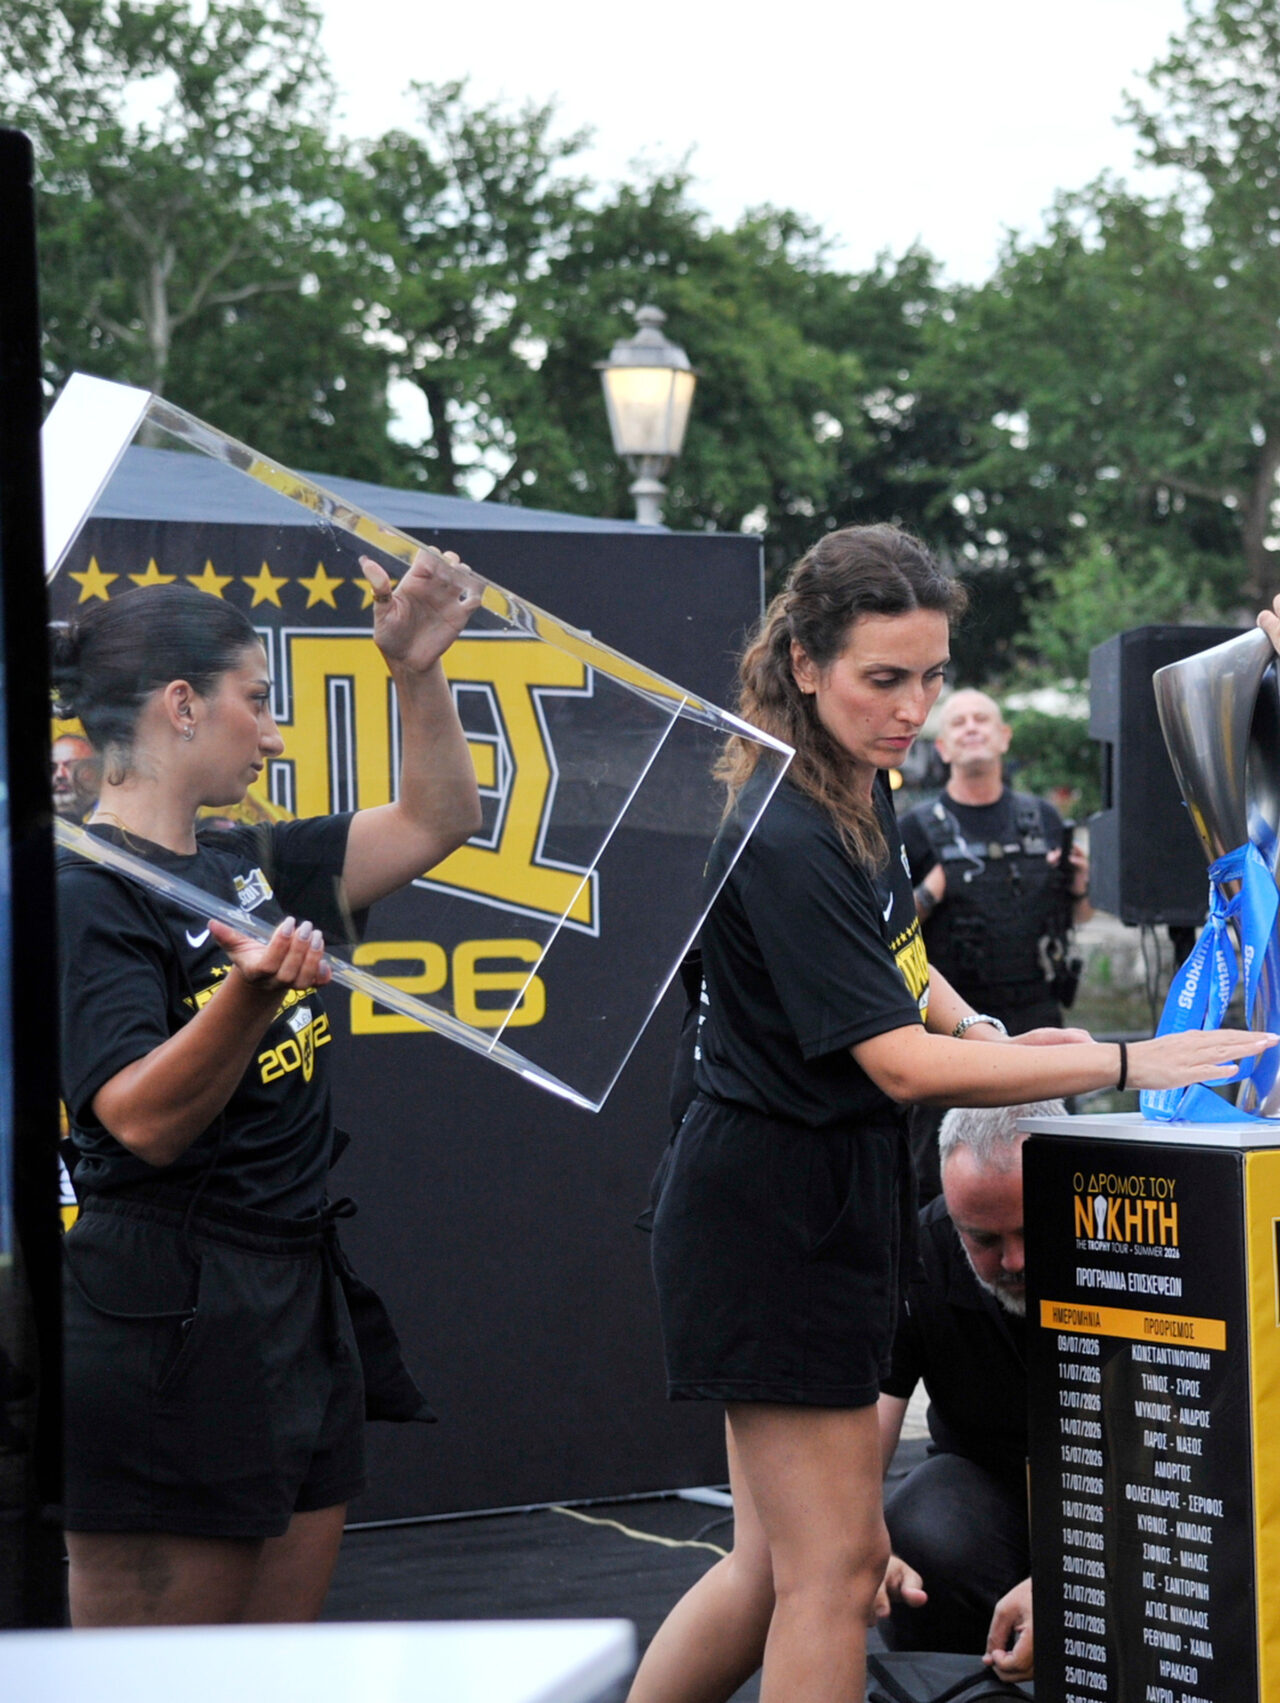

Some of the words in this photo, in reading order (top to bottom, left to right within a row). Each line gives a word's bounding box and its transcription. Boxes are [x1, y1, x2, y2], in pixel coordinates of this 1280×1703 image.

[1073, 1172, 1084, 1192] Ο
[1087, 1173, 1148, 1196] ΔΡΟΜΟΣ
[1149, 1177, 1176, 1197] ΤΟΥ
[1076, 1238, 1087, 1250] THE
[1087, 1240, 1110, 1251] TROPHY
[1111, 1242, 1129, 1254] TOUR
[1134, 1245, 1163, 1257] SUMMER
[1164, 1248, 1181, 1258] 2026
[1076, 1267, 1127, 1291] ΠΡΟΓΡΑΜΜΑ
[1128, 1272, 1182, 1297] ΕΠΙΣΚΕΨΕΩΝ
[1053, 1307, 1101, 1327] ΗΜΕΡΟΜΗΝΙΑ
[1143, 1317, 1195, 1339] ΠΡΟΟΡΙΣΜΟΣ
[1057, 1334, 1099, 1356] 09/07/2026
[1131, 1344, 1210, 1371] ΚΩΝΣΤΑΝΤΙΝΟΥΠΟΛΗ
[1058, 1363, 1101, 1384] 11/07/2026
[1141, 1373, 1169, 1392] ΤΗΝΟΣ
[1176, 1378, 1200, 1397] ΣΥΡΟΣ
[1059, 1390, 1101, 1412] 12/07/2026
[1135, 1400, 1171, 1420] ΜΥΚΟΝΟΣ
[1180, 1407, 1210, 1428] ΑΝΔΡΟΣ
[1060, 1418, 1102, 1440] 14/07/2026
[1143, 1430, 1168, 1450] ΠΑΡΟΣ
[1176, 1436, 1202, 1456] ΝΑΞΟΣ
[1061, 1445, 1103, 1467] 15/07/2026
[1154, 1461, 1191, 1483] ΑΜΟΡΓΟΣ
[1061, 1473, 1104, 1495] 17/07/2026
[1125, 1484, 1180, 1508] ΦΟΛΕΓΑΝΔΡΟΣ
[1189, 1496, 1224, 1518] ΣΕΡΙΦΟΣ
[1062, 1500, 1104, 1523] 18/07/2026
[1137, 1513, 1168, 1534] ΚΥΘΝΟΣ
[1176, 1523, 1213, 1544] ΚΙΜΩΛΟΣ
[1062, 1527, 1104, 1551] 19/07/2026
[1142, 1543, 1171, 1564] ΣΙΦΝΟΣ
[1180, 1552, 1209, 1573] ΜΗΛΟΣ
[1063, 1555, 1105, 1579] 20/07/2026
[1142, 1572, 1156, 1590] ΙΟΣ
[1164, 1578, 1210, 1601] ΣΑΝΤΟΡΙΝΗ
[1063, 1582, 1105, 1607] 21/07/2026
[1145, 1600, 1168, 1619] ΑΓΙΟΣ
[1170, 1606, 1209, 1631] ΝΙΚΟΛΑΟΣ
[1063, 1610, 1105, 1635] 22/07/2026
[1143, 1628, 1181, 1652] ΡΕΘΥΜΝΟ
[1189, 1637, 1214, 1660] ΧΑΝΙΑ
[1064, 1638, 1107, 1664] 23/07/2026
[1159, 1660, 1198, 1685] ΗΡΑΚΛΕΙΟ
[1065, 1666, 1108, 1691] 25/07/2026
[1146, 1684, 1174, 1703] ΛΑΥΡΙΟ
